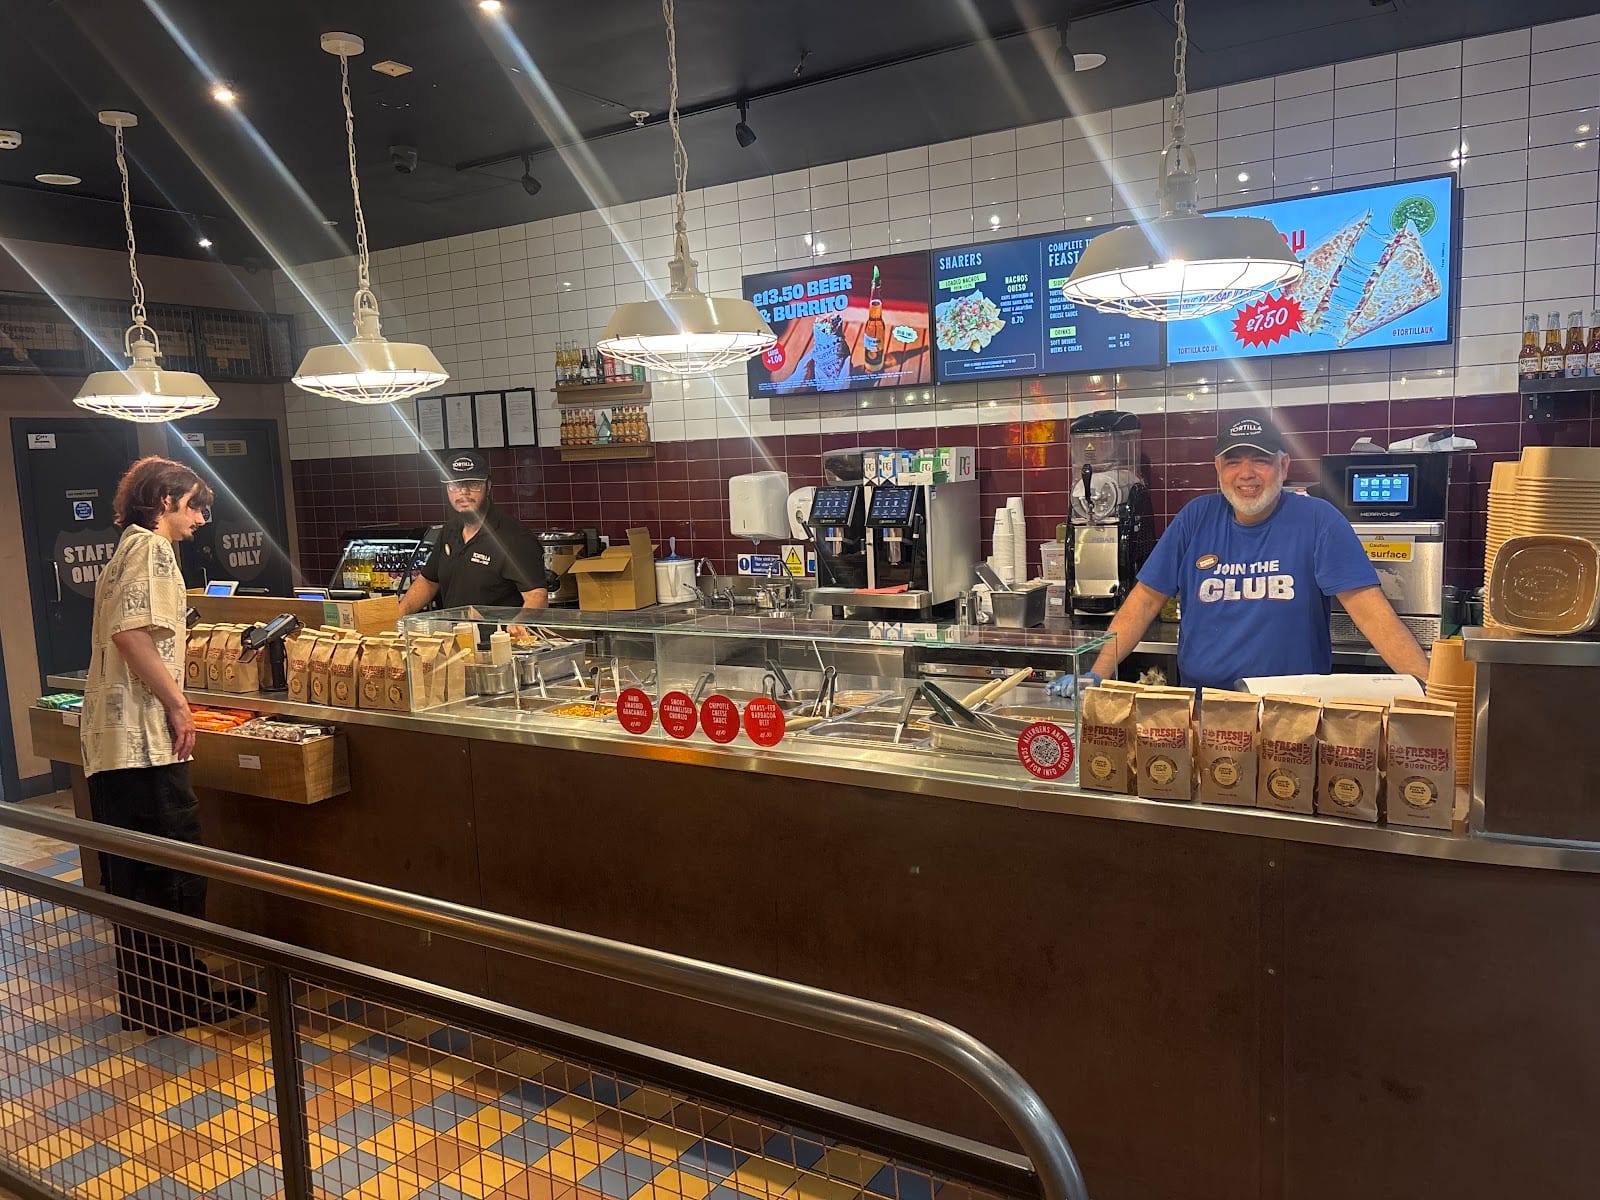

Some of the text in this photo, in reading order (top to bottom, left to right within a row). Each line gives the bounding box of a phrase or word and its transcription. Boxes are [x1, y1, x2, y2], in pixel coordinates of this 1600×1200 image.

[1048, 240, 1083, 252] COMPLETE
[939, 252, 982, 270] SHARERS
[1049, 251, 1079, 267] FEAST
[1004, 274, 1028, 284] NACHOS
[753, 274, 852, 307] £13.50 BEER
[1007, 284, 1026, 293] QUESO
[760, 294, 848, 323] & BURRITO
[1012, 316, 1024, 324] 8.70
[1246, 307, 1288, 332] £7.50
[1392, 326, 1433, 336] @TORTILLAUK
[222, 532, 264, 549] STAFF
[64, 543, 114, 564] STAFF
[229, 550, 260, 567] ONLY
[1371, 550, 1407, 558] surface
[1214, 560, 1279, 575] JOIN THE
[72, 564, 105, 584] ONL
[1199, 574, 1295, 602] CLUB
[664, 705, 692, 714] CARAMELISED
[709, 702, 730, 710] CHIPOTLE
[1094, 725, 1119, 736] FRESH
[1150, 727, 1177, 737] FRESH
[1216, 730, 1242, 740] FRESH
[1023, 726, 1070, 771] ALLERGENS AND CALORIES
[1094, 739, 1119, 747] BURRITO
[1274, 740, 1303, 752] FRESH
[1336, 746, 1365, 757] FRESH
[1405, 747, 1437, 758] FRESH
[1021, 747, 1057, 776] SCAN FOR INFO
[1274, 756, 1303, 764] BURRITO
[1334, 762, 1366, 770] BURRITO
[1404, 762, 1438, 771] BURRITO
